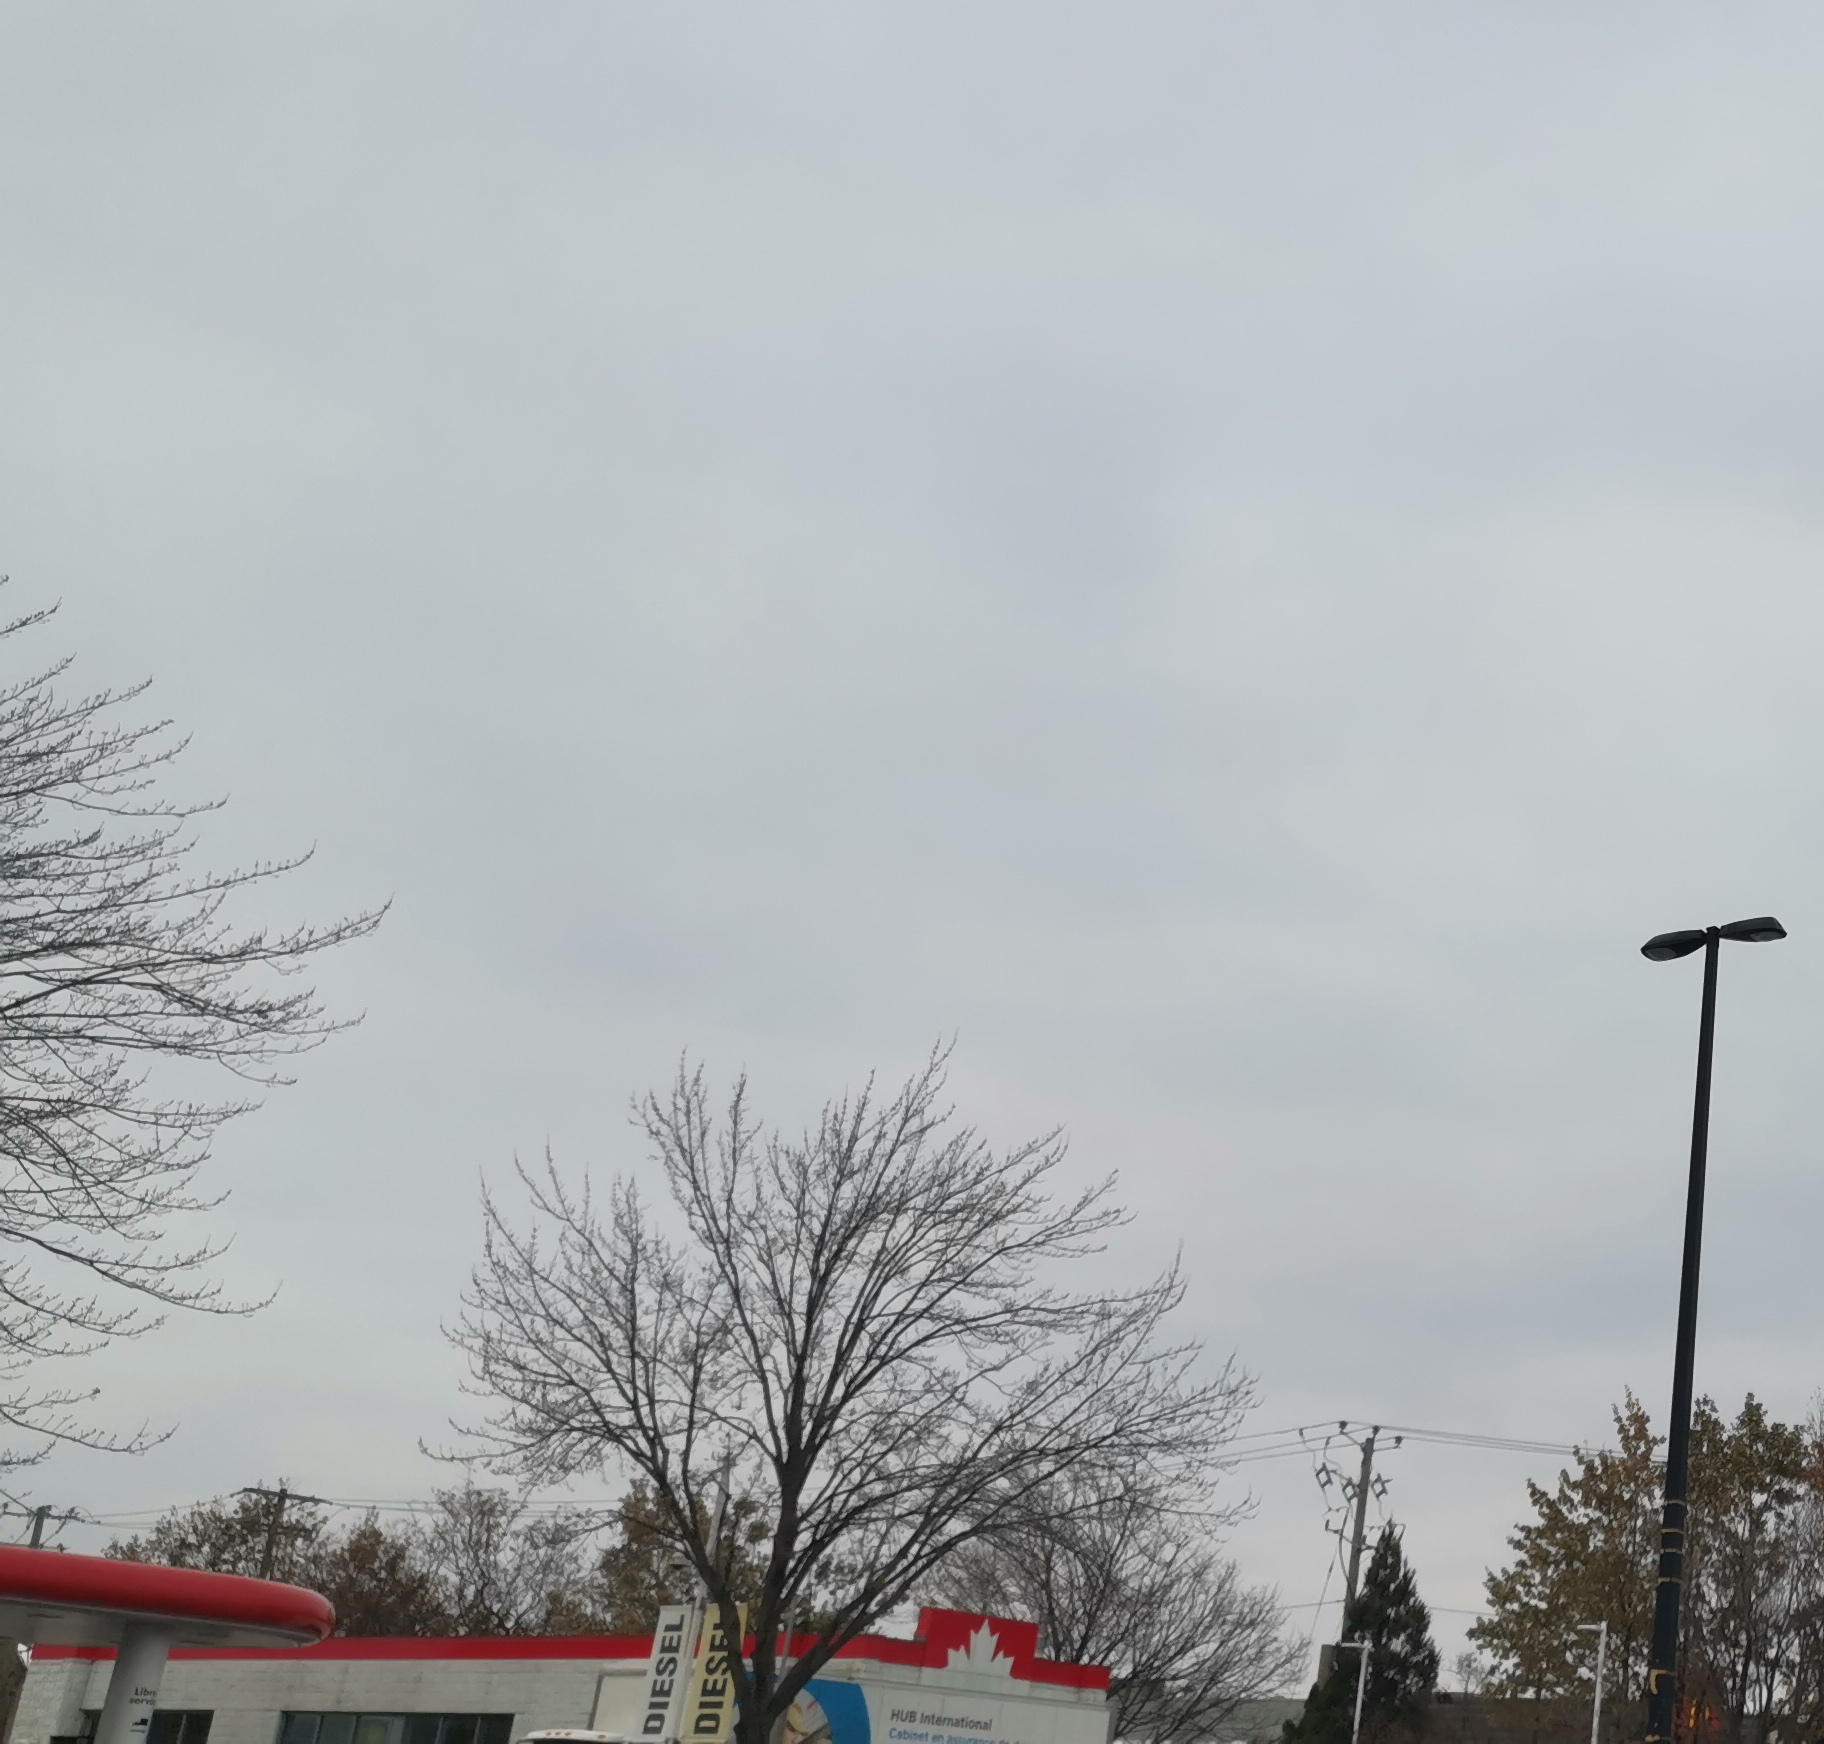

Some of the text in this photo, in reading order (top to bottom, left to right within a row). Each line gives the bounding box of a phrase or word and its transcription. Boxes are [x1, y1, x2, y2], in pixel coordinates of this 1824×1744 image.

[642, 1613, 685, 1735] DIESEL
[891, 1709, 993, 1732] HUB International
[889, 1727, 929, 1742] Cabinet
